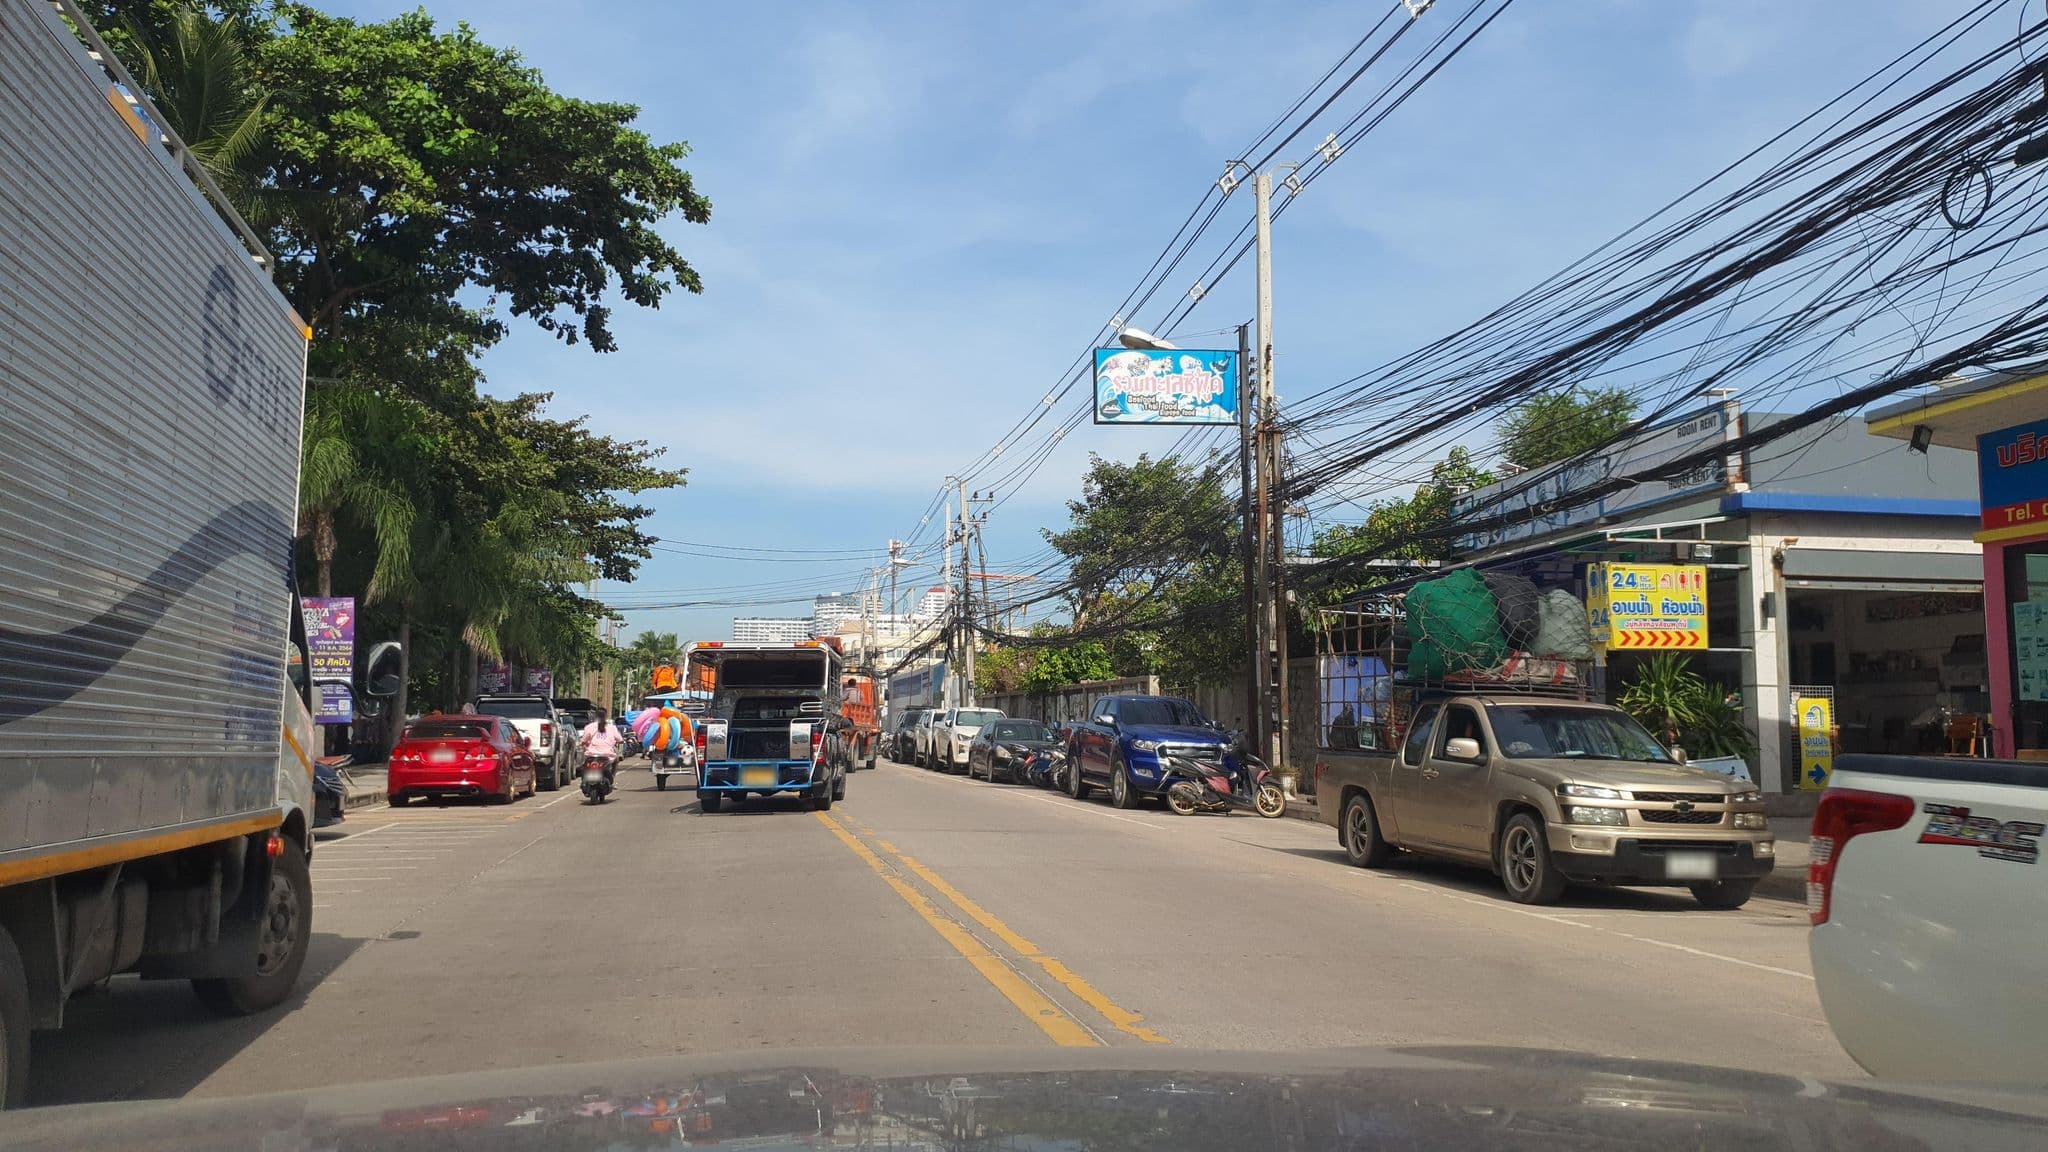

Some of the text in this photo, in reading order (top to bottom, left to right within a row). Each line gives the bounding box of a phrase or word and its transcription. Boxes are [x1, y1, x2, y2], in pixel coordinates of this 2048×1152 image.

[1160, 400, 1179, 411] food
[1677, 415, 1717, 438] ROOM RENT
[2004, 502, 2035, 522] Tel.
[1612, 572, 1637, 588] 24
[1611, 594, 1704, 615] อาบน้ำ ห้องน้ำ
[1591, 607, 1610, 627] 24
[313, 657, 325, 666] 50
